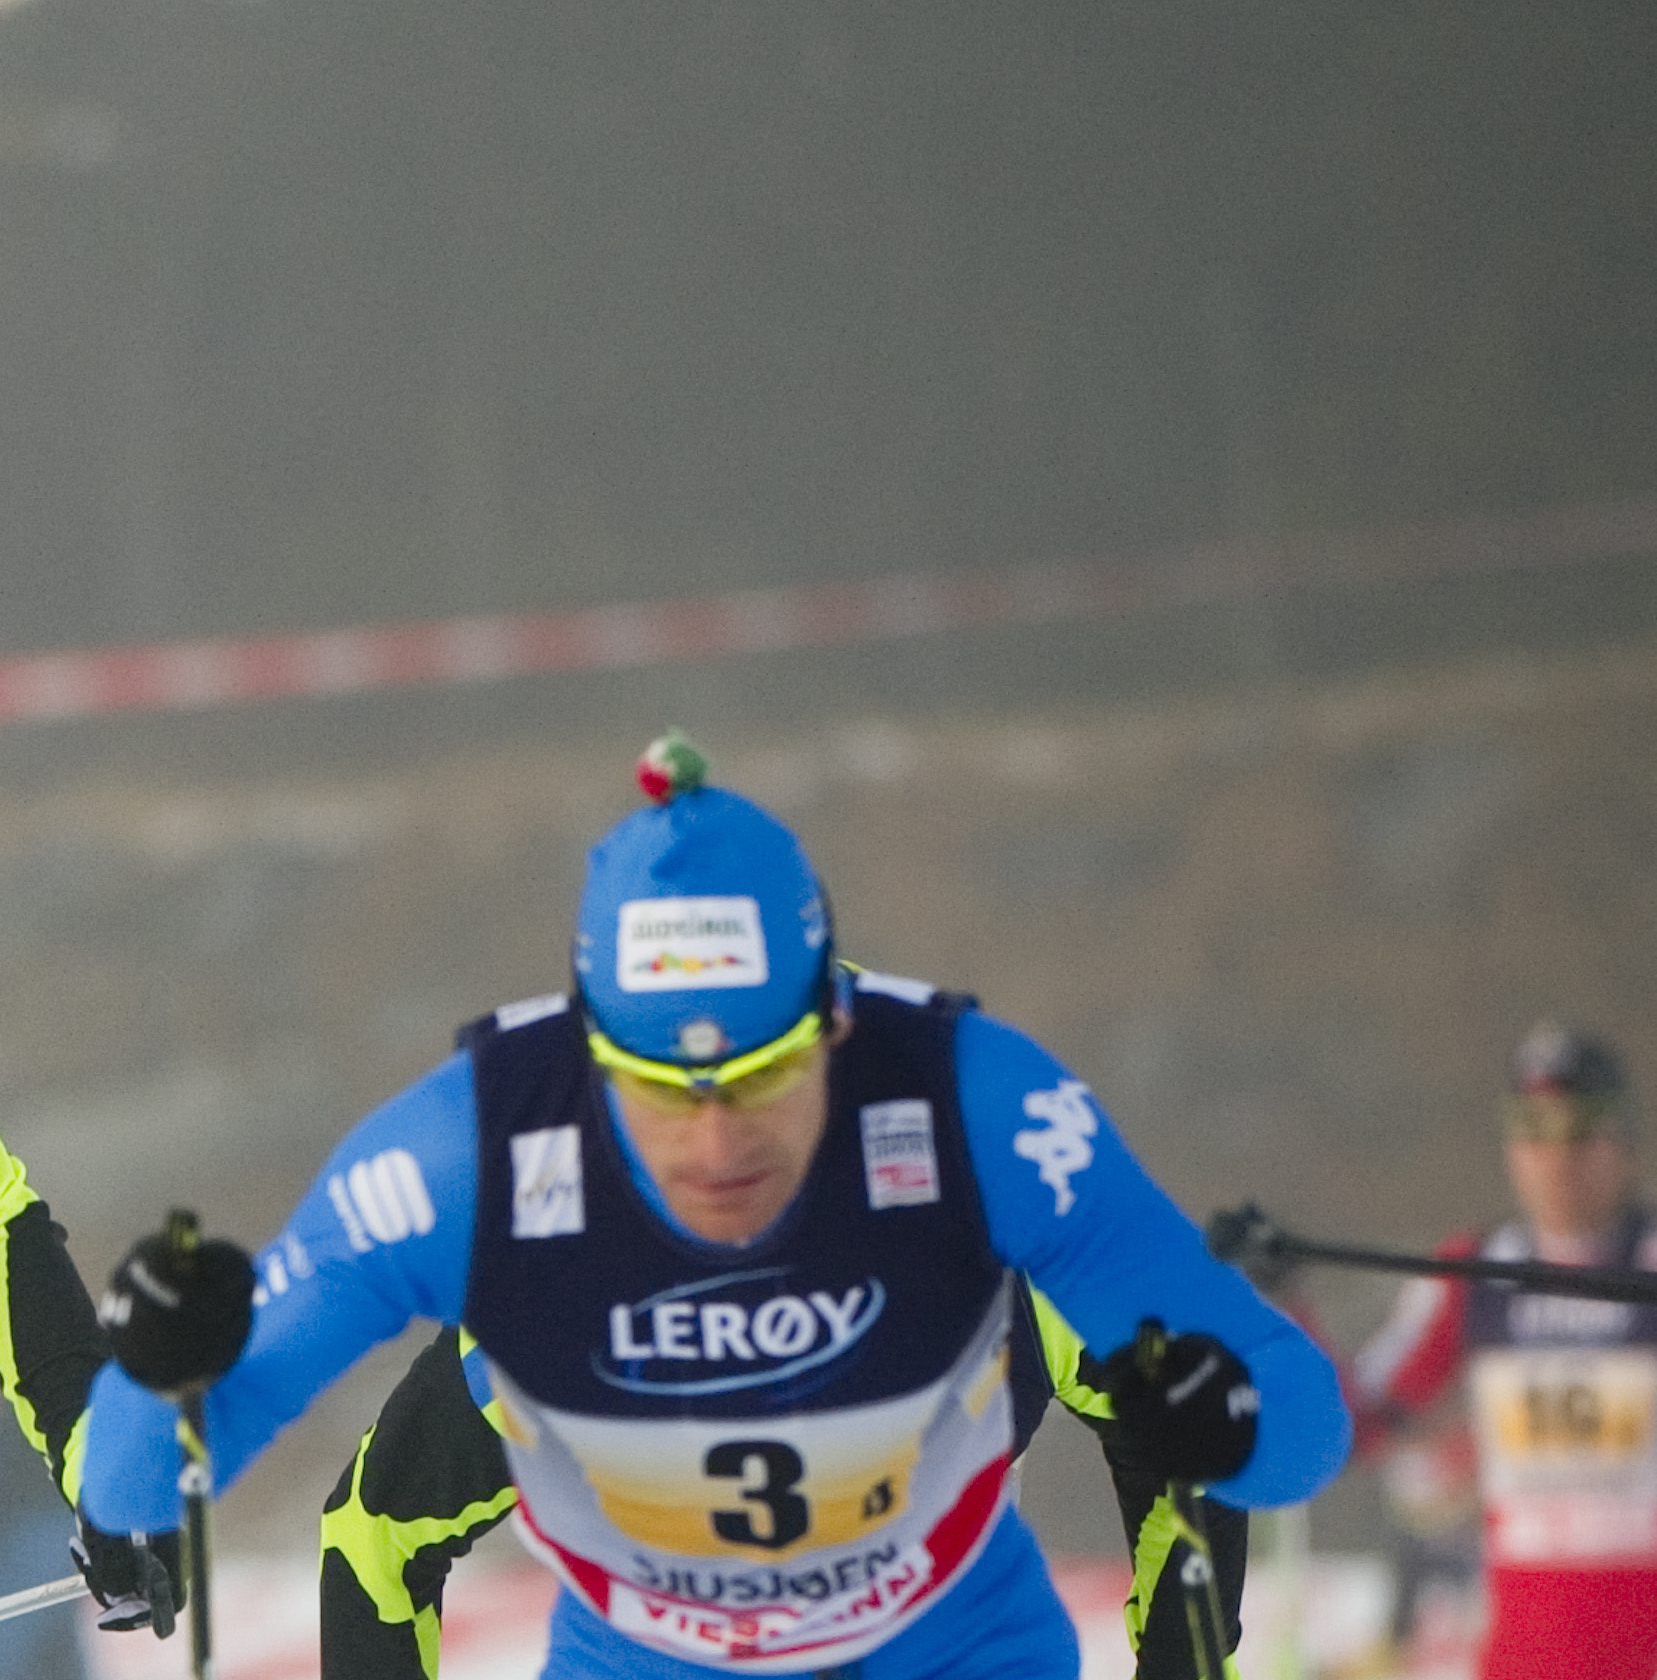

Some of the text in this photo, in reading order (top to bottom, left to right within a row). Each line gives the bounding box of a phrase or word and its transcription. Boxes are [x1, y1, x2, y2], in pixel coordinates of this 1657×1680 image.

[609, 1286, 865, 1361] LERØY
[703, 1437, 811, 1550] 3
[632, 1541, 901, 1604] SJUSJØEN
